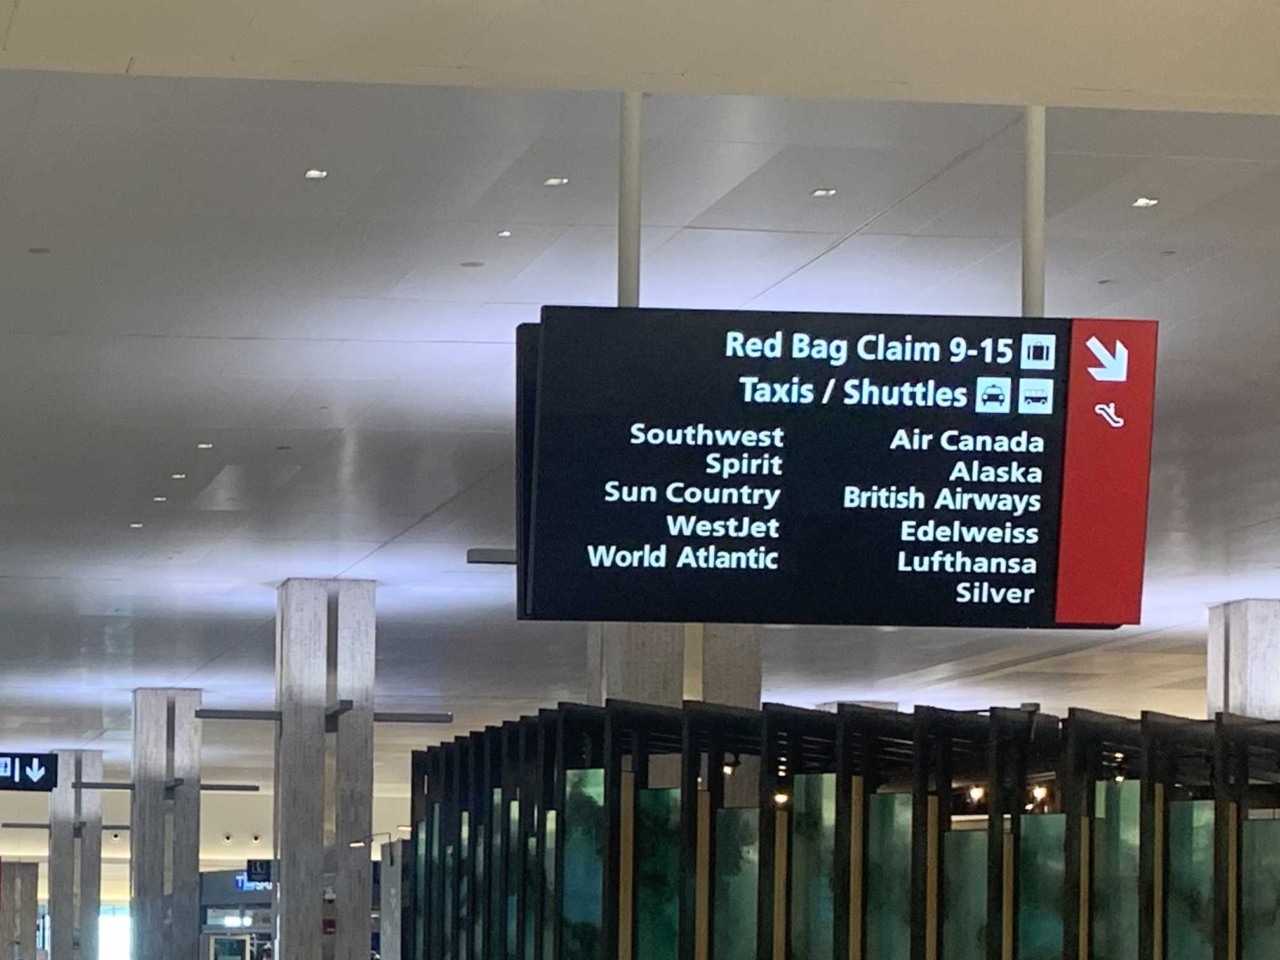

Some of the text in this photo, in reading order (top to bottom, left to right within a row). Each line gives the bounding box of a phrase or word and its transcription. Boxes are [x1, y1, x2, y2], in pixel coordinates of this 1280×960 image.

[726, 331, 1013, 366] Red Bag Claim 9-15
[739, 377, 967, 407] Taxis / Shuttles
[631, 423, 784, 447] Southwest
[890, 429, 1044, 452] Air Canada
[706, 453, 782, 478] Spirit
[949, 460, 1042, 483] Alaska
[605, 481, 781, 509] Sun Country
[844, 486, 1040, 516] British Airways
[667, 516, 779, 537] WestJet
[901, 520, 1038, 543] Edelweiss
[588, 544, 778, 569] World Atlantic
[898, 551, 1036, 573] Lufthansa
[957, 582, 1034, 603] Silver
